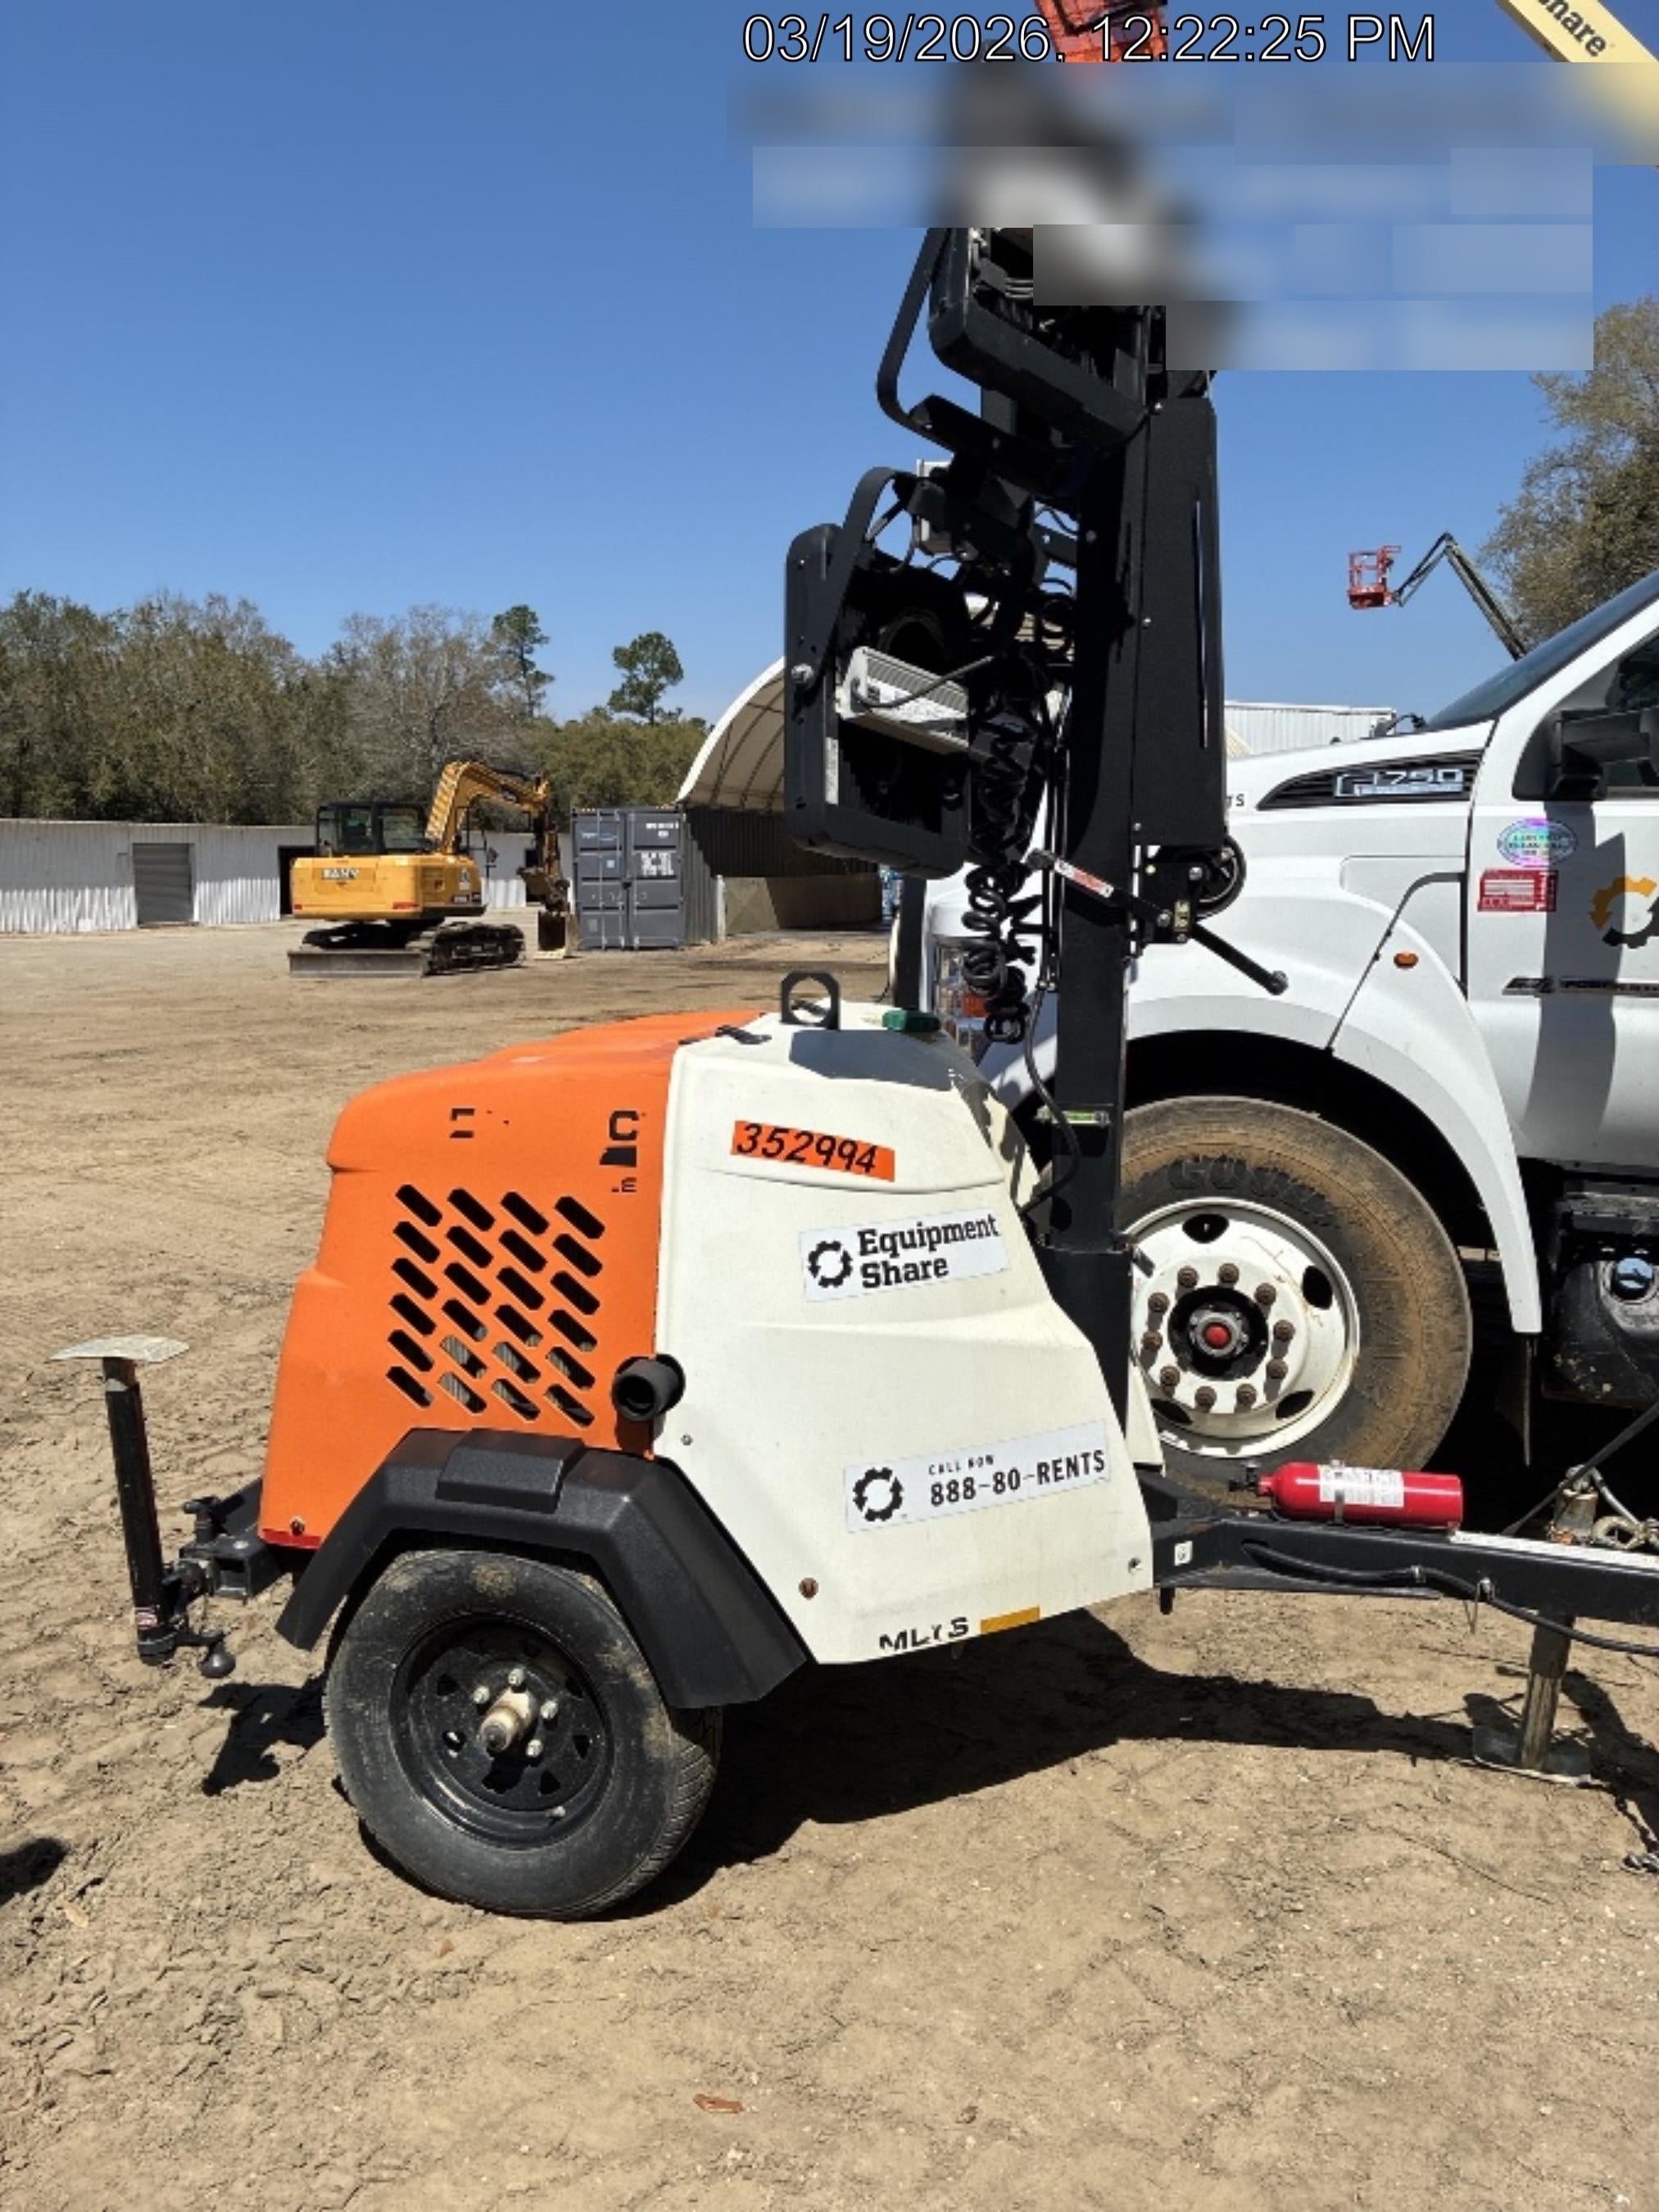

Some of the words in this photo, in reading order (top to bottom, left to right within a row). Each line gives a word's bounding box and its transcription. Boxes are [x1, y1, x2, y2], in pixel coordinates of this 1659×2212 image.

[1537, 0, 1607, 57] hare
[737, 1122, 877, 1173] 352994
[857, 1213, 1000, 1258] Equipment
[859, 1257, 949, 1289] Share
[928, 1461, 962, 1475] CALL
[930, 1448, 1105, 1507] 888-80-RENTS
